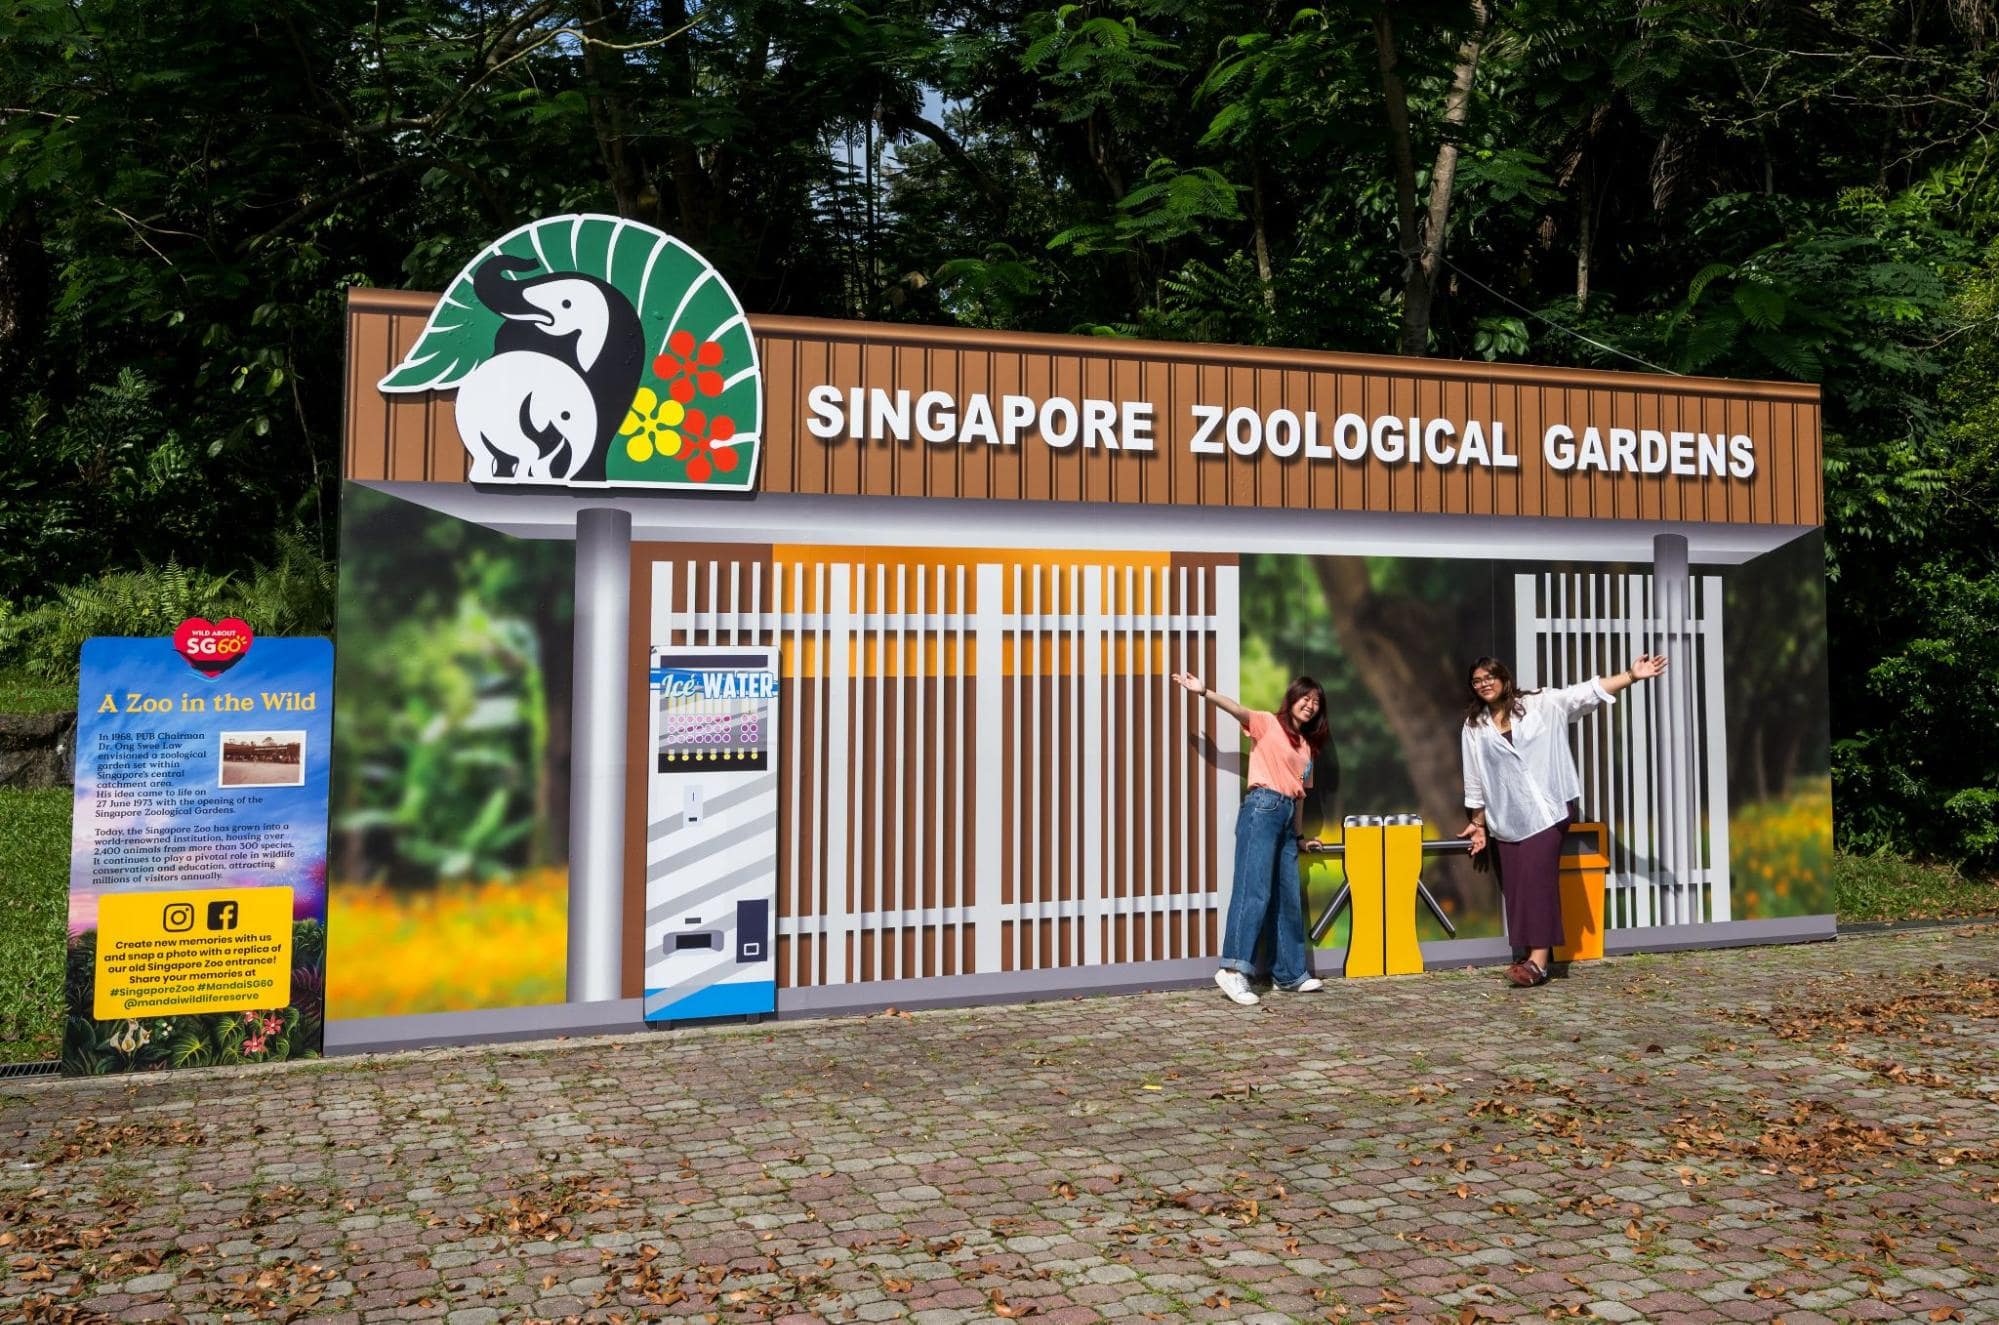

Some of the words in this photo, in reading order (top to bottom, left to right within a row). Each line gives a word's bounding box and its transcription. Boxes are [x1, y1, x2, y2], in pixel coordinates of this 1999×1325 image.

[806, 385, 1154, 451] SINGAPORE
[1190, 405, 1517, 467] ZOOLOGICAL
[1544, 423, 1755, 478] GARDENS
[186, 637, 241, 654] SG60
[661, 672, 696, 697] Ice
[702, 672, 774, 698] WATER
[98, 694, 117, 713] A
[125, 693, 172, 713] Zoo
[181, 693, 204, 712] in
[214, 693, 254, 711] the
[260, 691, 316, 711] Wild
[157, 732, 204, 740] Chairman
[114, 742, 134, 751] Ong
[137, 742, 160, 750] Swee
[97, 752, 149, 760] envisioned
[160, 751, 206, 759] zoological
[97, 761, 130, 771] garden
[151, 770, 184, 778] central
[96, 790, 111, 798] His
[114, 789, 134, 797] idea
[177, 788, 192, 796] life
[96, 800, 107, 808] 27
[156, 798, 176, 806] with
[180, 798, 194, 806] the
[197, 796, 234, 806] opening
[236, 796, 245, 804] of
[248, 795, 263, 804] the
[95, 809, 142, 819] Singapore
[144, 808, 192, 817] Zoological
[194, 806, 235, 814] Gardens.
[95, 828, 124, 836] Today,
[127, 827, 142, 835] the
[145, 826, 191, 835] Singapore
[213, 824, 229, 832] has
[231, 825, 260, 833] grown
[94, 835, 170, 845] world-renowned
[173, 834, 223, 843] institution,
[226, 833, 261, 841] housing
[123, 846, 160, 854] animals
[164, 845, 185, 853] from
[239, 842, 258, 850] 300
[93, 857, 100, 865] It
[164, 855, 184, 864] play
[195, 852, 227, 862] pivotal
[230, 852, 247, 860] role
[262, 850, 295, 858] wildlife
[93, 866, 154, 874] conservation
[178, 862, 226, 871] education,
[229, 861, 275, 870] attracting
[92, 875, 130, 884] millions
[145, 874, 178, 882] visitors
[180, 872, 223, 881] annually.
[115, 940, 152, 949] Create
[154, 939, 176, 947] new
[179, 936, 232, 945] memories
[235, 934, 257, 942] with
[104, 953, 125, 961] and
[128, 953, 154, 961] snap
[166, 950, 197, 960] photo
[199, 947, 222, 956] with
[233, 945, 269, 956] replica
[271, 944, 281, 952] of
[128, 963, 145, 972] old
[147, 961, 202, 972] Singapore
[204, 960, 223, 968] Zoo
[225, 956, 276, 966] entrance!
[129, 975, 160, 984] Share
[163, 974, 187, 984] your
[189, 969, 242, 980] memories
[110, 985, 195, 997] #SingaporeZoo
[197, 979, 273, 991] #MandaiSG60
[124, 993, 259, 1010] @mandaiwildlifereserve
